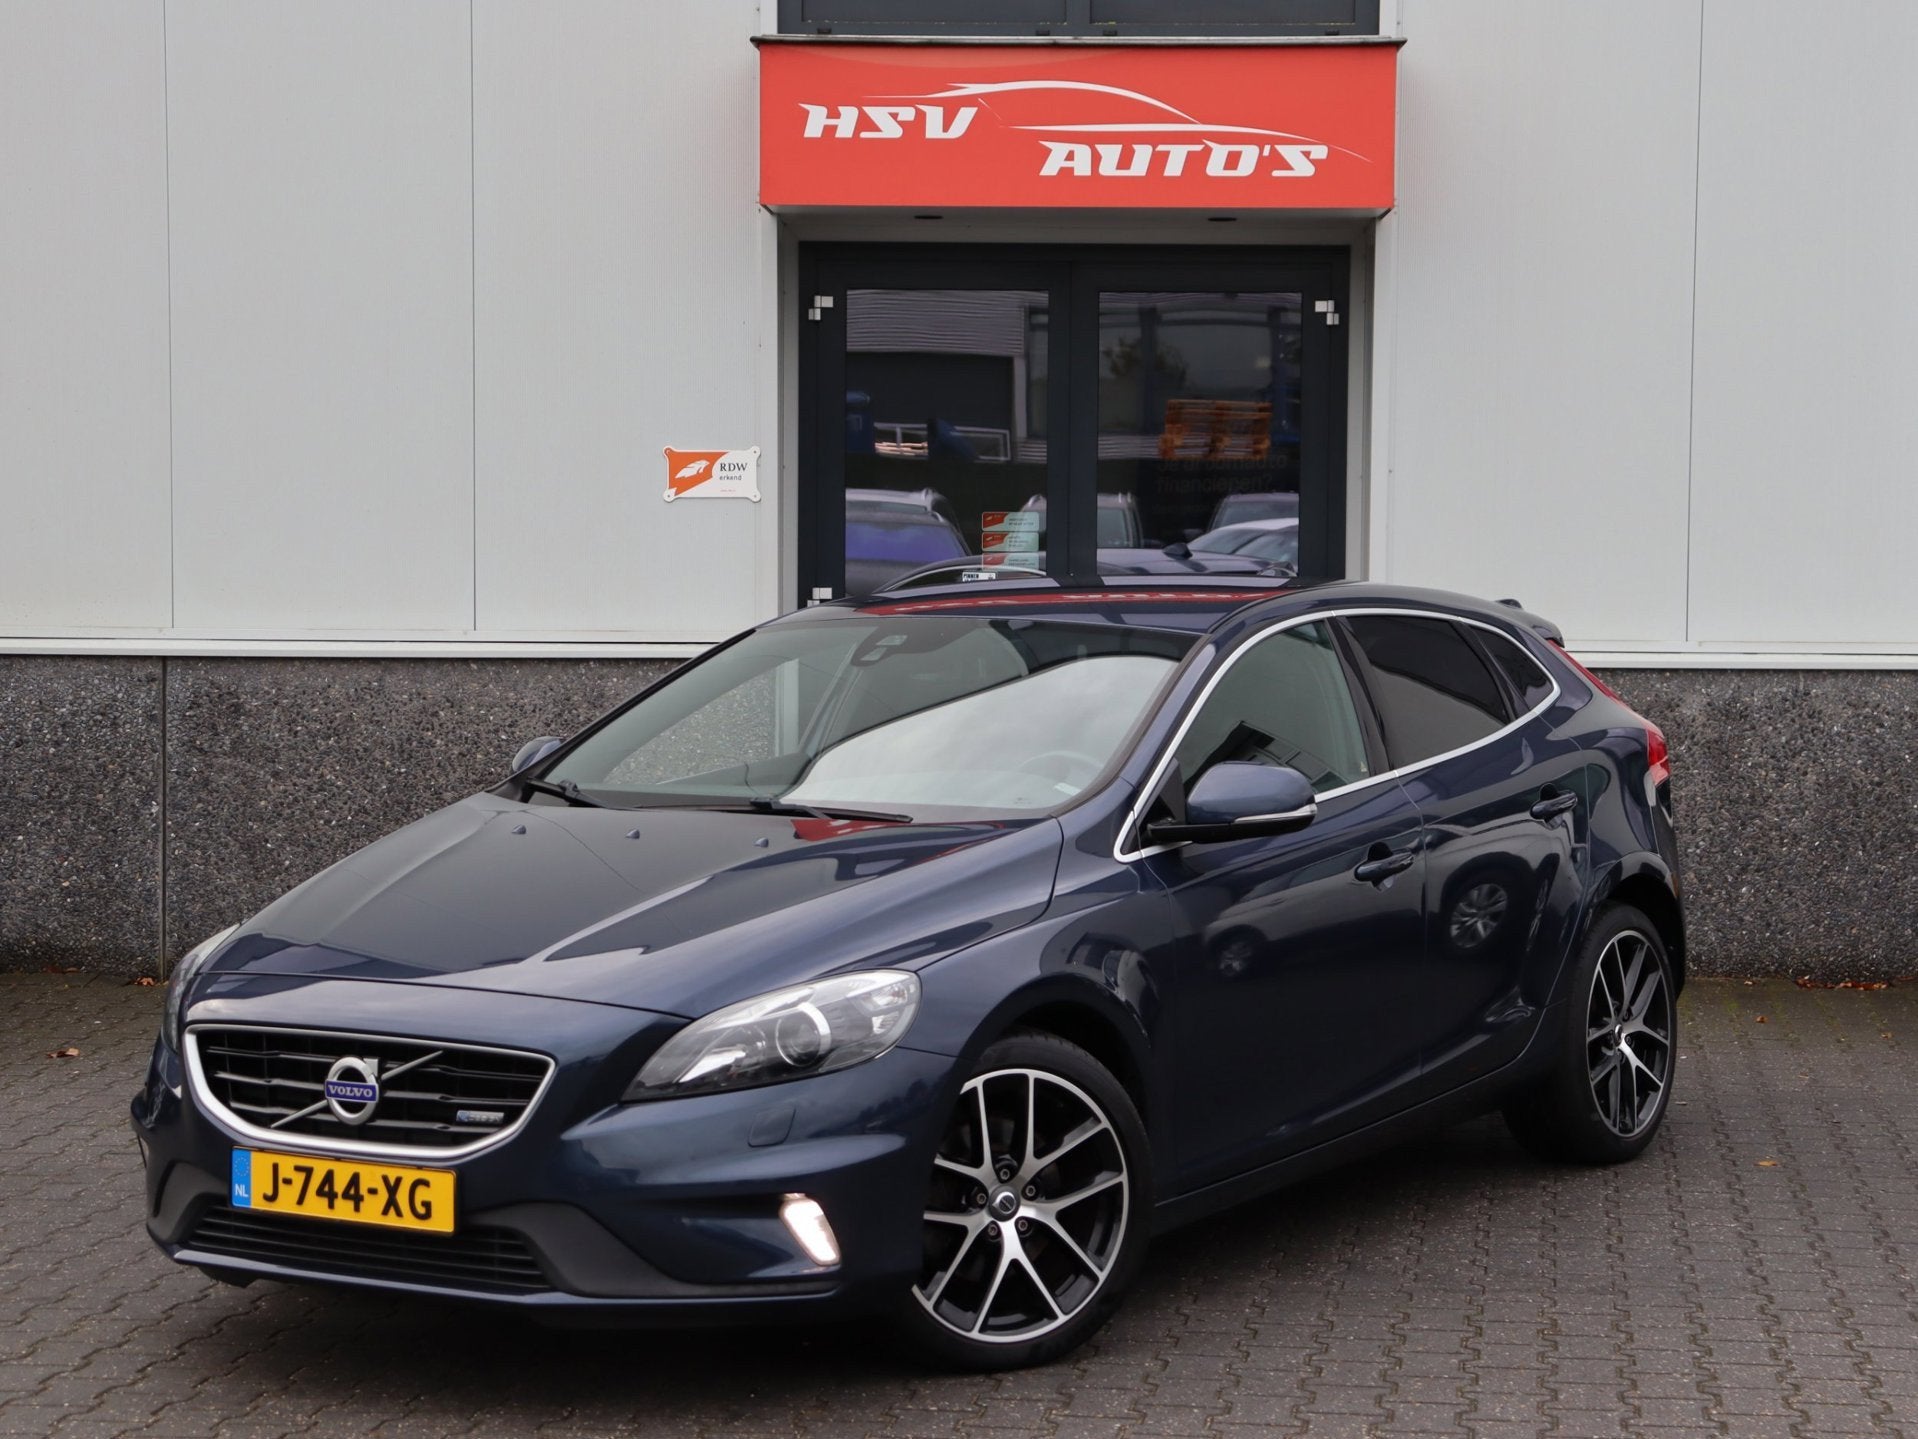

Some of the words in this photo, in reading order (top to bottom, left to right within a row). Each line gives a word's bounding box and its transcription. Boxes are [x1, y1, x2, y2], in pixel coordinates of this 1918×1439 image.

[798, 103, 978, 139] HSV
[1038, 139, 1328, 177] AUTO'S
[720, 462, 748, 472] RDW
[327, 1084, 374, 1099] VOLVO
[235, 1184, 249, 1198] NL
[262, 1162, 432, 1220] J-744-XG
